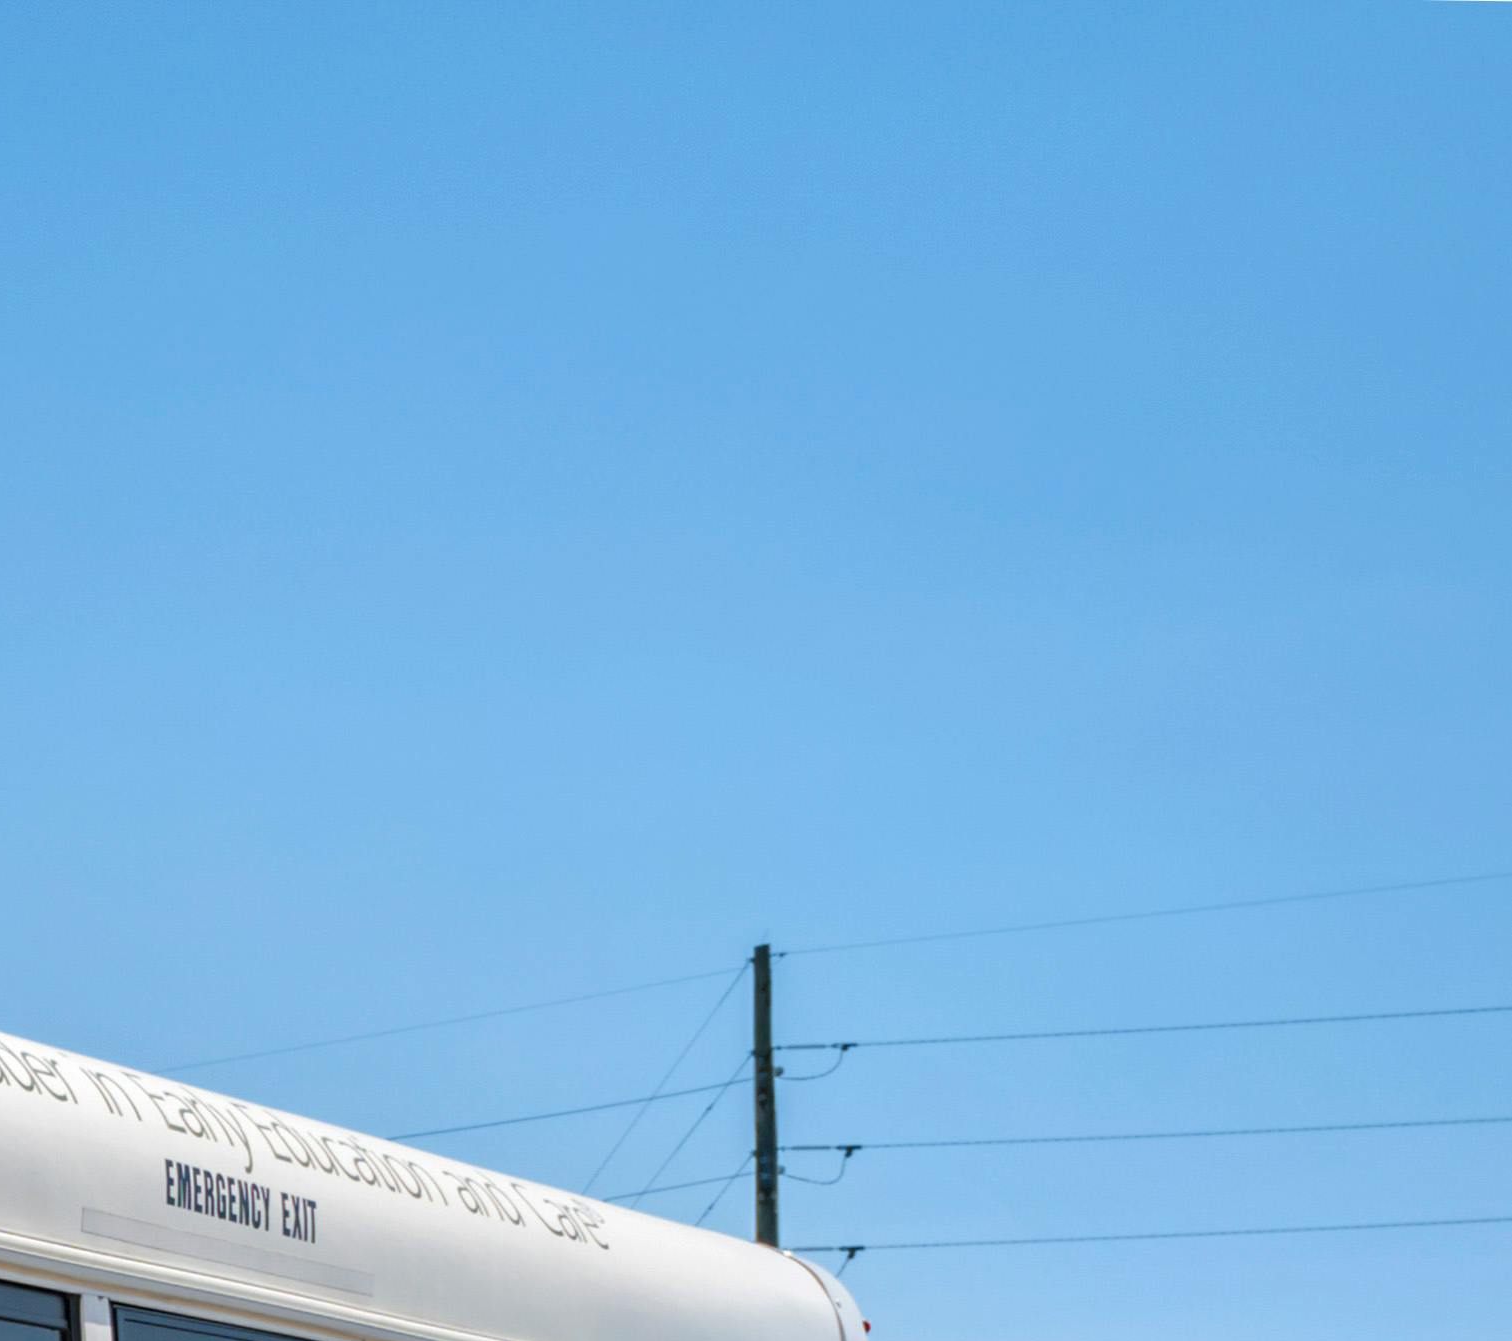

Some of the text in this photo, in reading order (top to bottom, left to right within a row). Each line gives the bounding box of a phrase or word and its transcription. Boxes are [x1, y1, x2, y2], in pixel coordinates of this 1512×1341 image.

[69, 1062, 142, 1122] in
[122, 1071, 253, 1173] Early
[231, 1102, 449, 1206] Education
[442, 1169, 526, 1227] and
[164, 1157, 318, 1245] EMERGENCY EXIT
